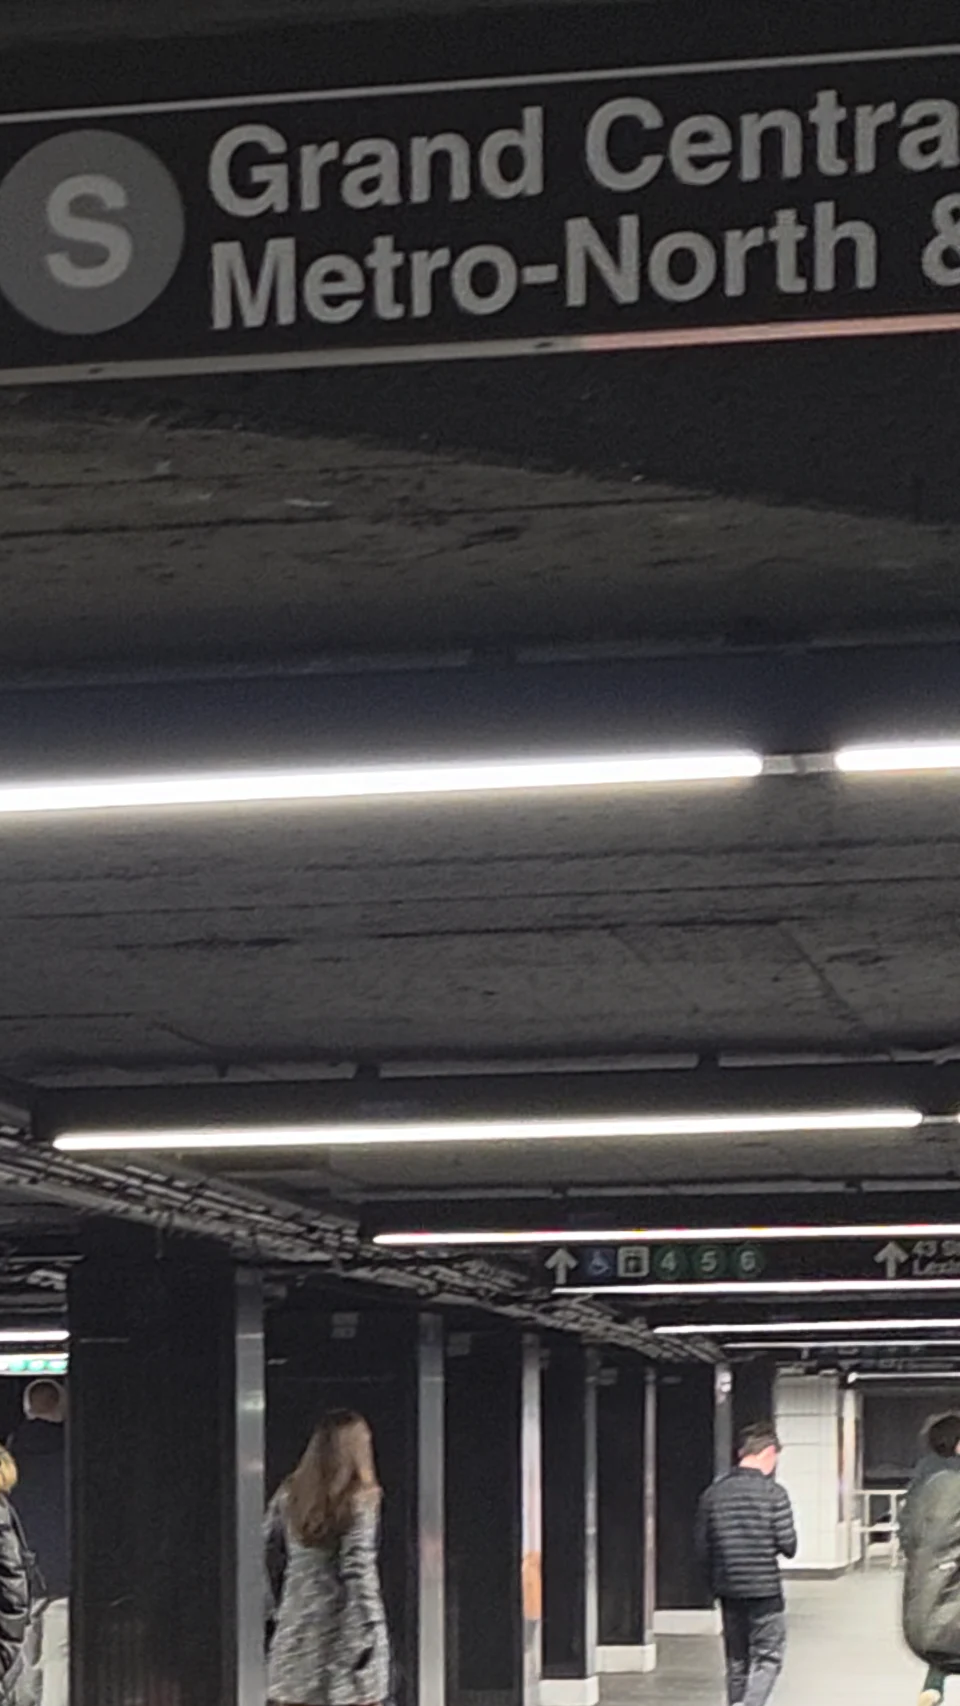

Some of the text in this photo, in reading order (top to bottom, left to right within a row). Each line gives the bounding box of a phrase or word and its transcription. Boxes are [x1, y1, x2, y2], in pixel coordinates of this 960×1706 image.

[208, 90, 960, 217] Grand Centra
[44, 173, 134, 289] S
[209, 192, 960, 330] Metro-North &
[660, 1249, 677, 1272] 4
[701, 1248, 717, 1272] 5
[740, 1249, 756, 1272] 6
